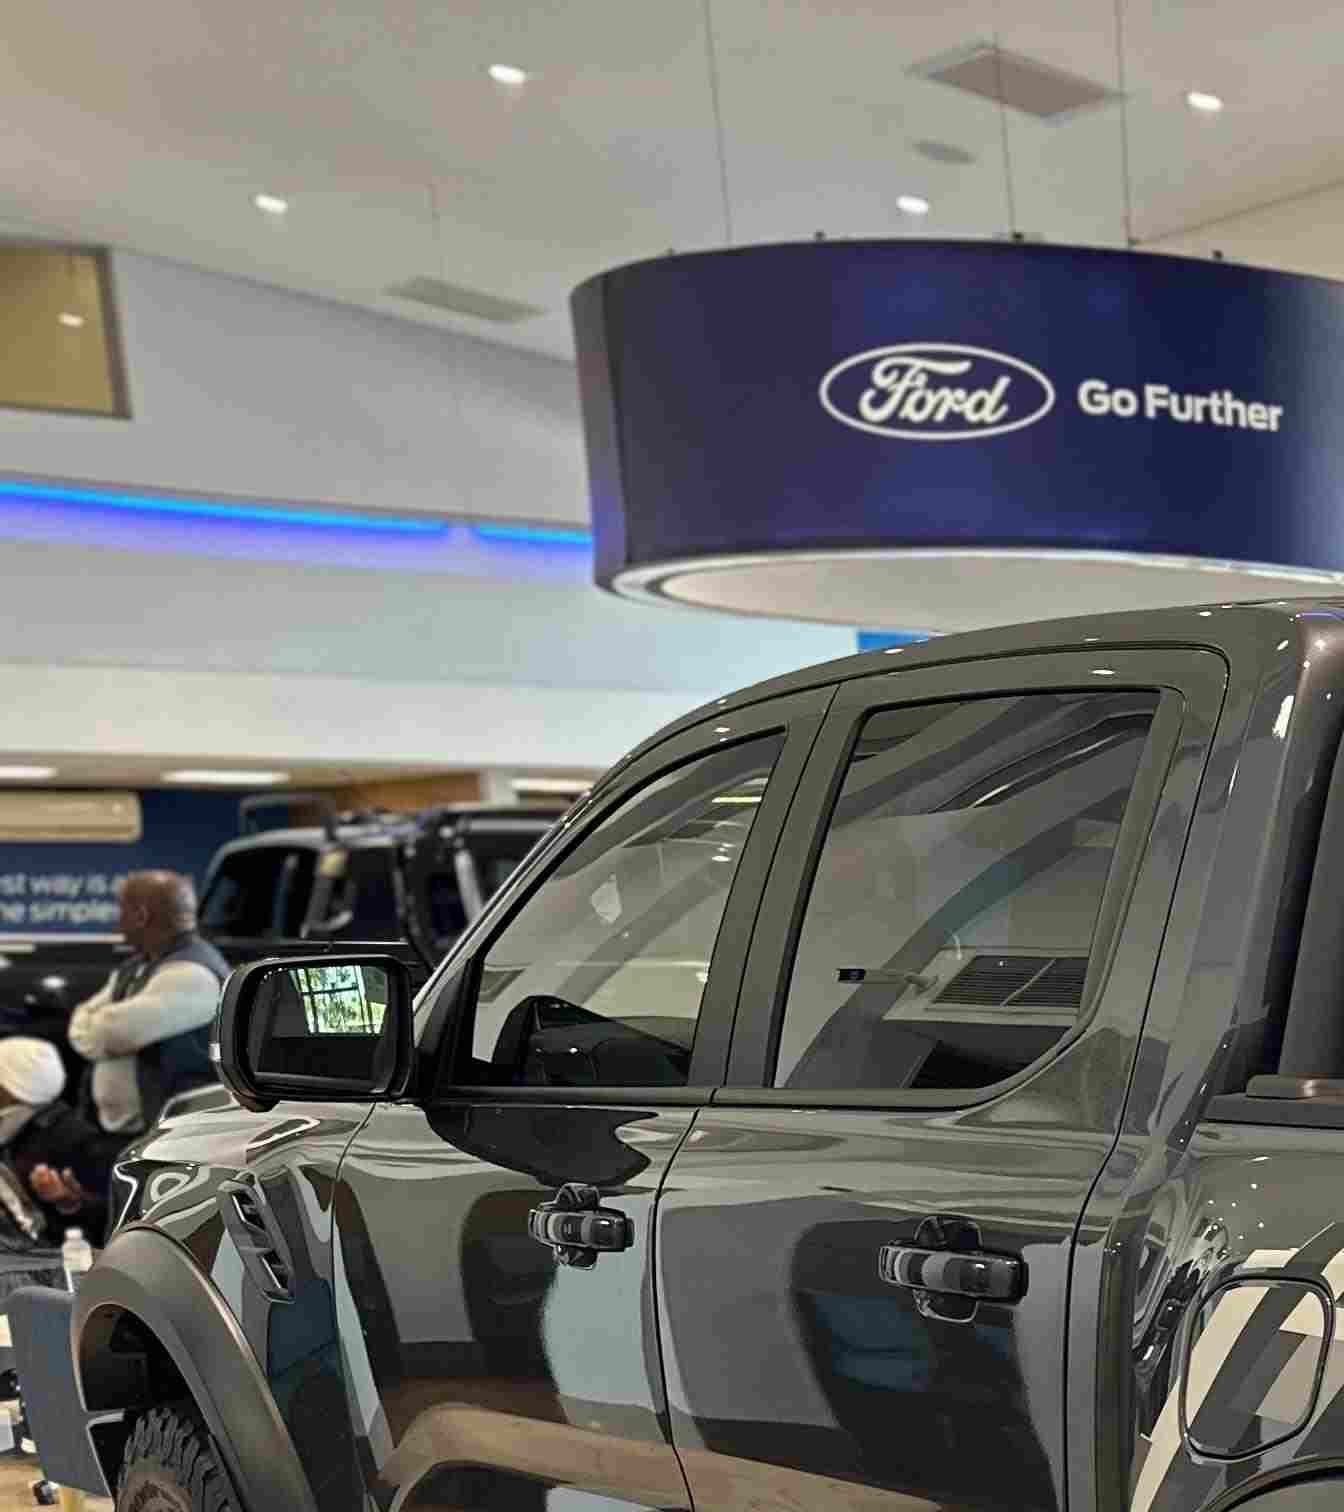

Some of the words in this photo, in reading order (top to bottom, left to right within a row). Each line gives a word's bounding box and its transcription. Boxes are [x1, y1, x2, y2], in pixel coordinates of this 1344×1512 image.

[859, 355, 1011, 424] Ford
[1078, 379, 1138, 417] Go
[1144, 382, 1284, 432] Further
